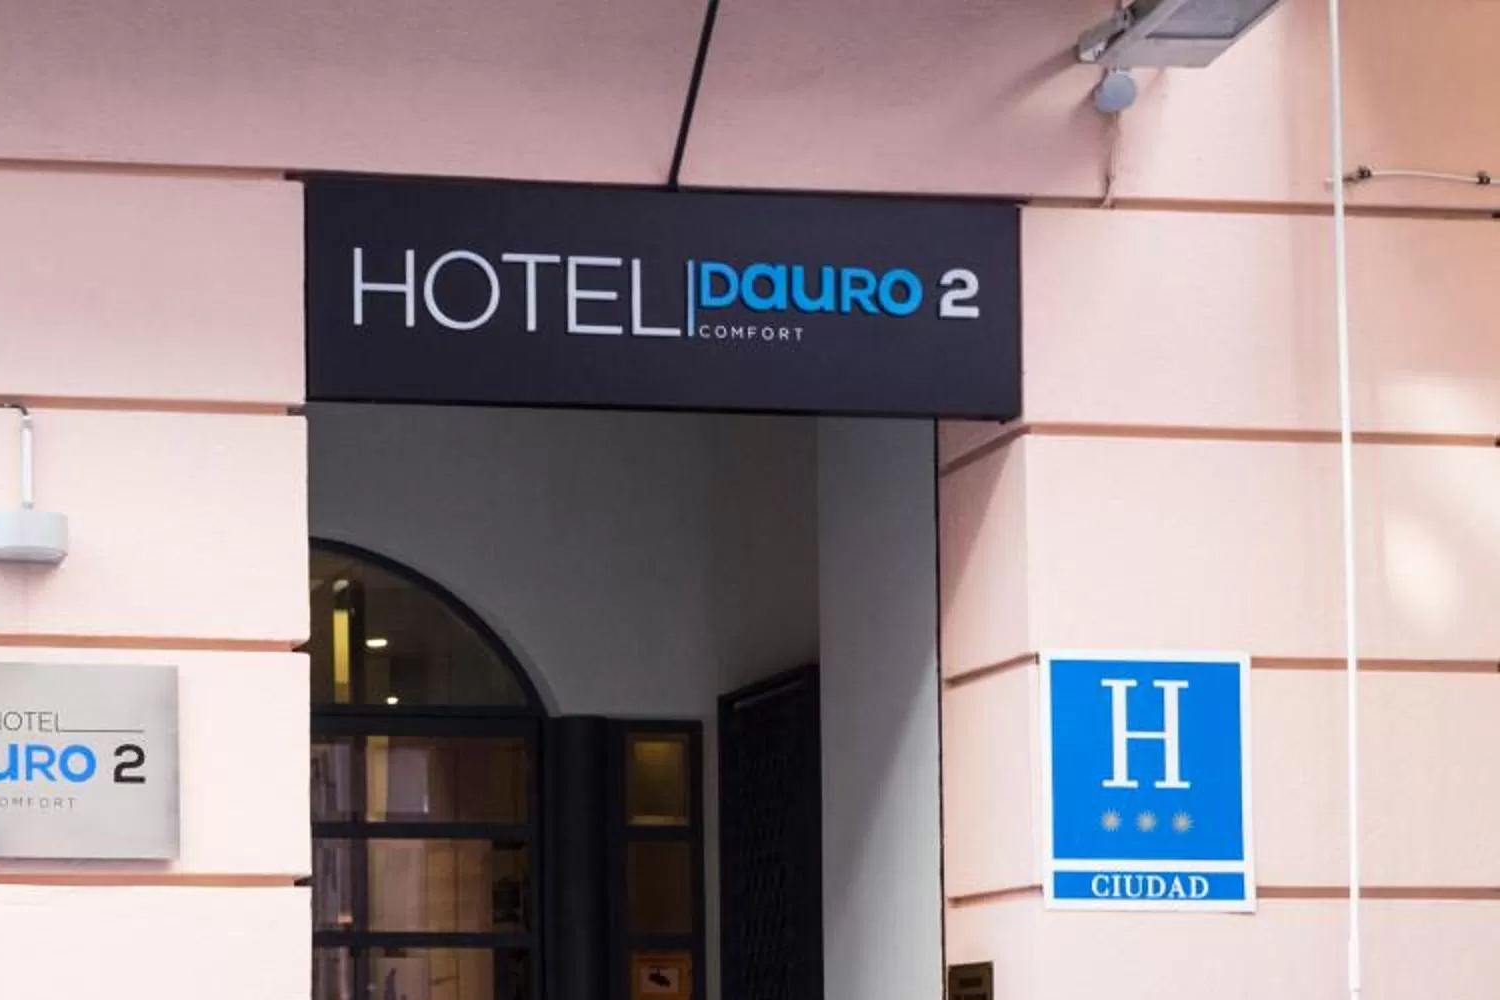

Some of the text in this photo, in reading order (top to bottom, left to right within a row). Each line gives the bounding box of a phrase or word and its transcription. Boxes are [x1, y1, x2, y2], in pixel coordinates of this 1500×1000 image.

[353, 246, 682, 337] HOTEL
[939, 268, 981, 319] 2
[699, 324, 804, 341] COMFORT
[1101, 678, 1191, 789] H
[112, 743, 147, 784] 2
[1091, 874, 1209, 899] CIUDAD
